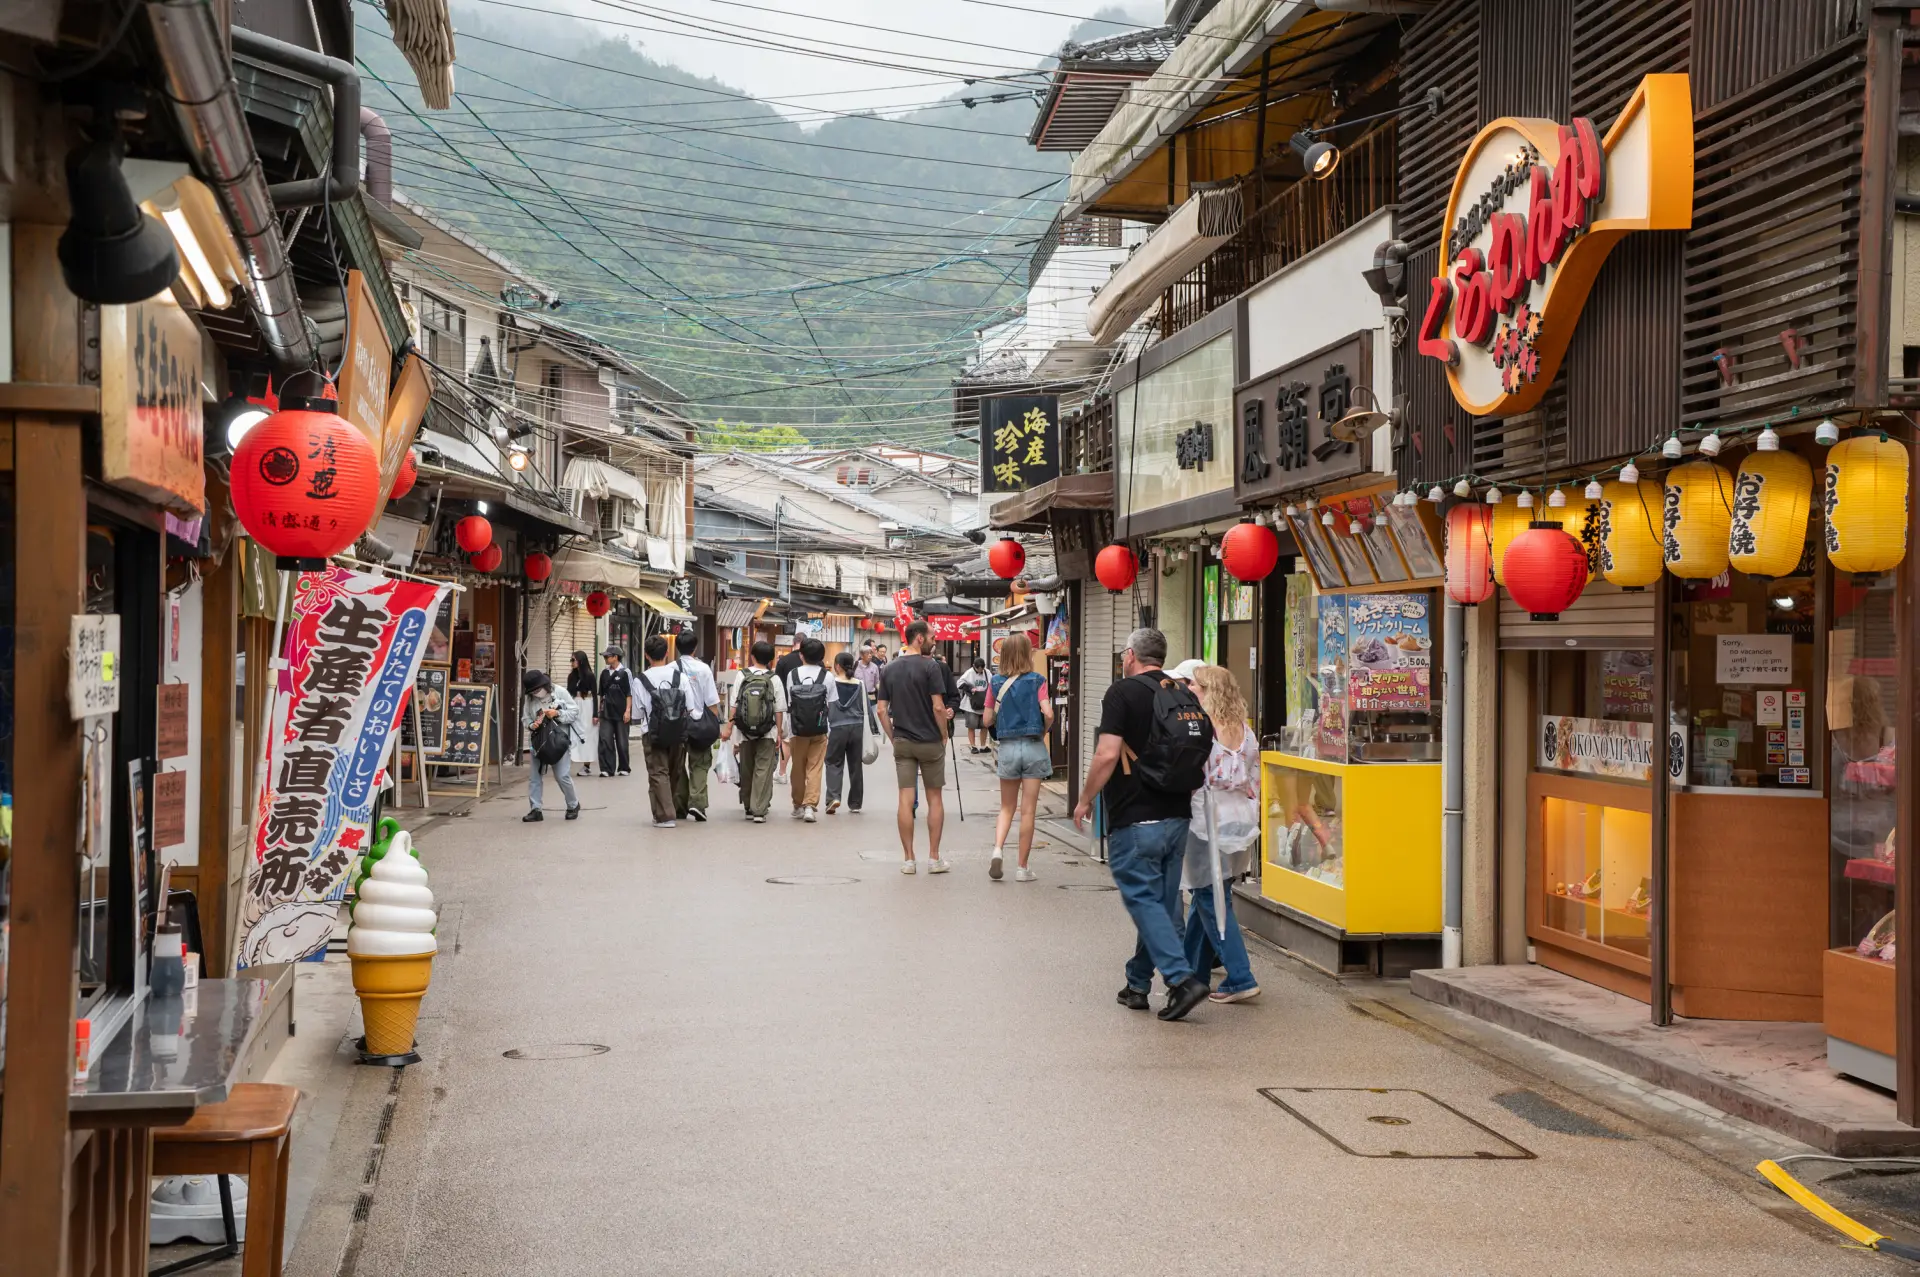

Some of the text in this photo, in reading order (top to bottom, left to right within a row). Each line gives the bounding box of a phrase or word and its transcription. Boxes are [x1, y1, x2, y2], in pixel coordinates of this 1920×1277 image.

[1022, 407, 1051, 466] 海産
[993, 420, 1024, 486] 珍味
[262, 511, 338, 532] 清盛通り
[1352, 603, 1400, 624] 焼き芋
[1358, 620, 1422, 634] ソフトクリーム
[1409, 657, 1429, 667] 500円
[1372, 674, 1406, 684] マツコの
[346, 618, 420, 799] とれたてのおいしさ
[1356, 698, 1426, 709] 紹介されました!
[254, 598, 389, 898] 生産者直売所
